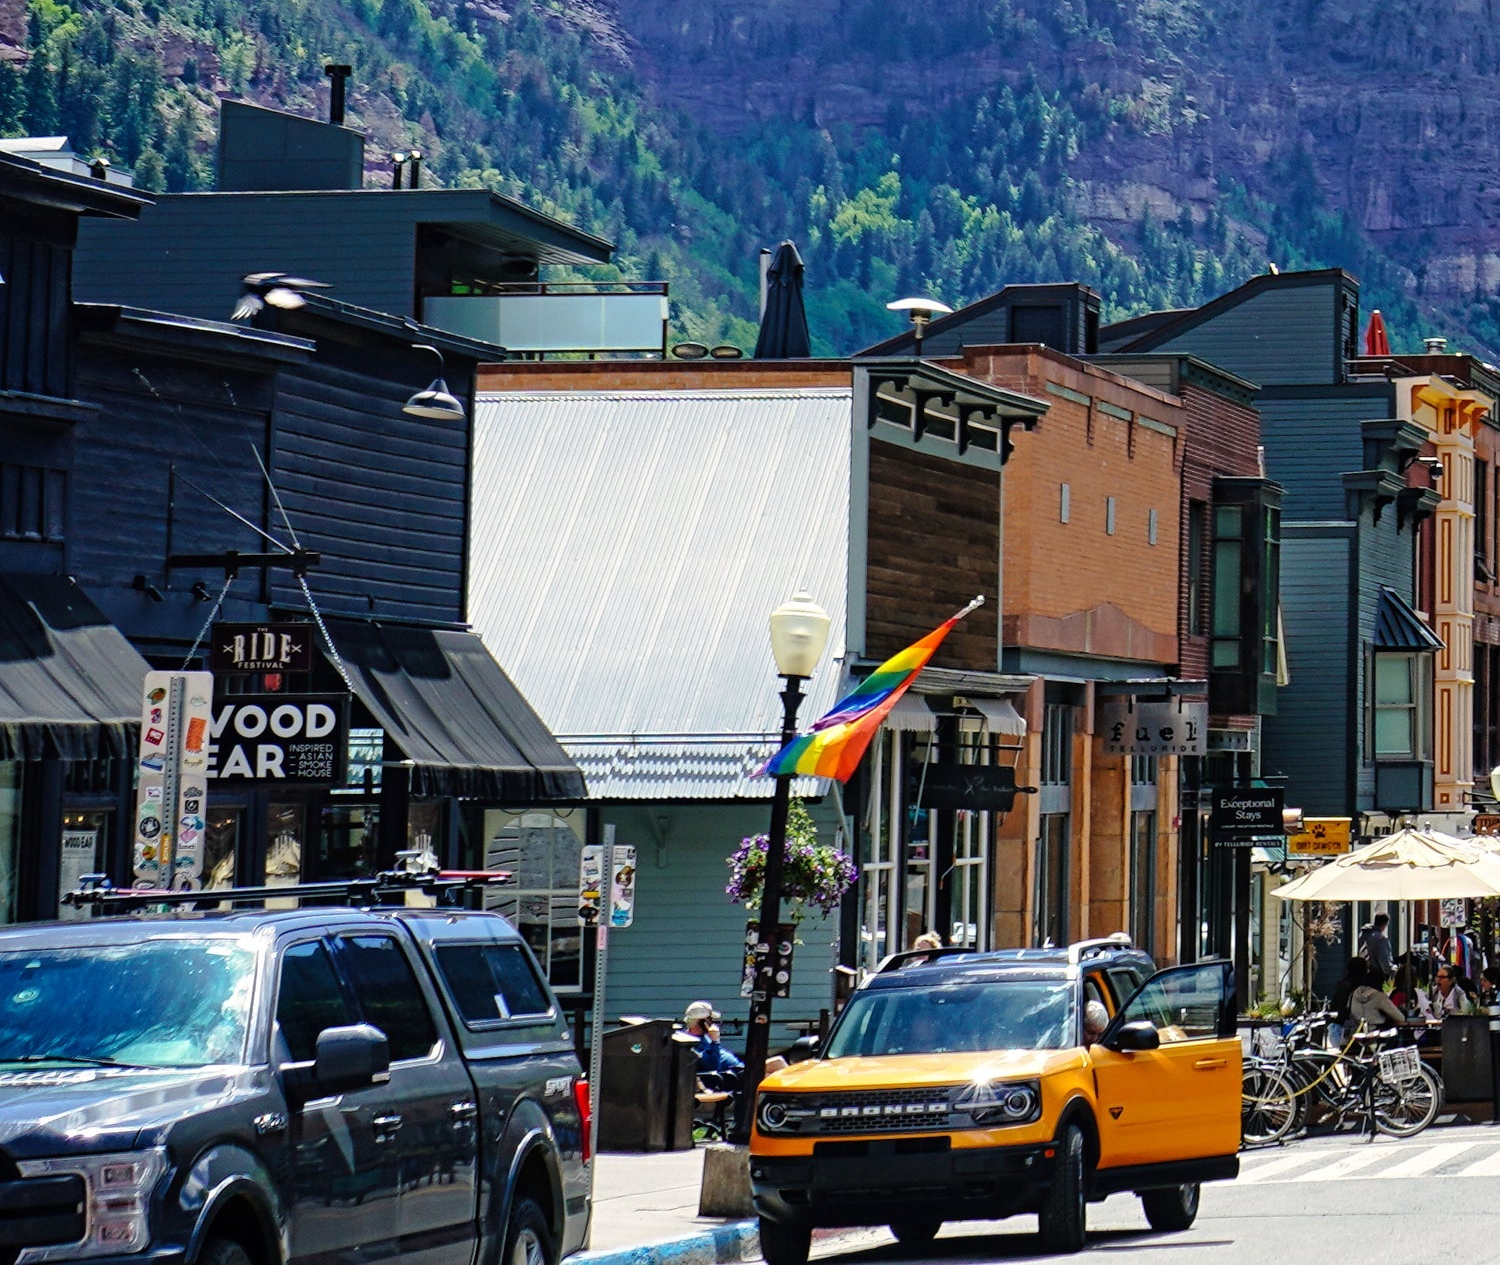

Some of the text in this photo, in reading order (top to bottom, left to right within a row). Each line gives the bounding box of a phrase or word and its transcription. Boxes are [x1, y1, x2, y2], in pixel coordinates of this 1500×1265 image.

[232, 632, 292, 664] RIDE
[237, 661, 284, 669] FESTIVAL
[1110, 717, 1198, 742] fuel
[289, 743, 334, 753] INSPIRED
[1109, 744, 1198, 753] TELLURIDE
[299, 752, 334, 760] ASIAN
[298, 760, 332, 769] SMOKE
[297, 769, 332, 777] HOUSE
[1220, 797, 1275, 810] Exceptional
[1235, 810, 1261, 822] Stays
[820, 1101, 948, 1117] BRONCO
